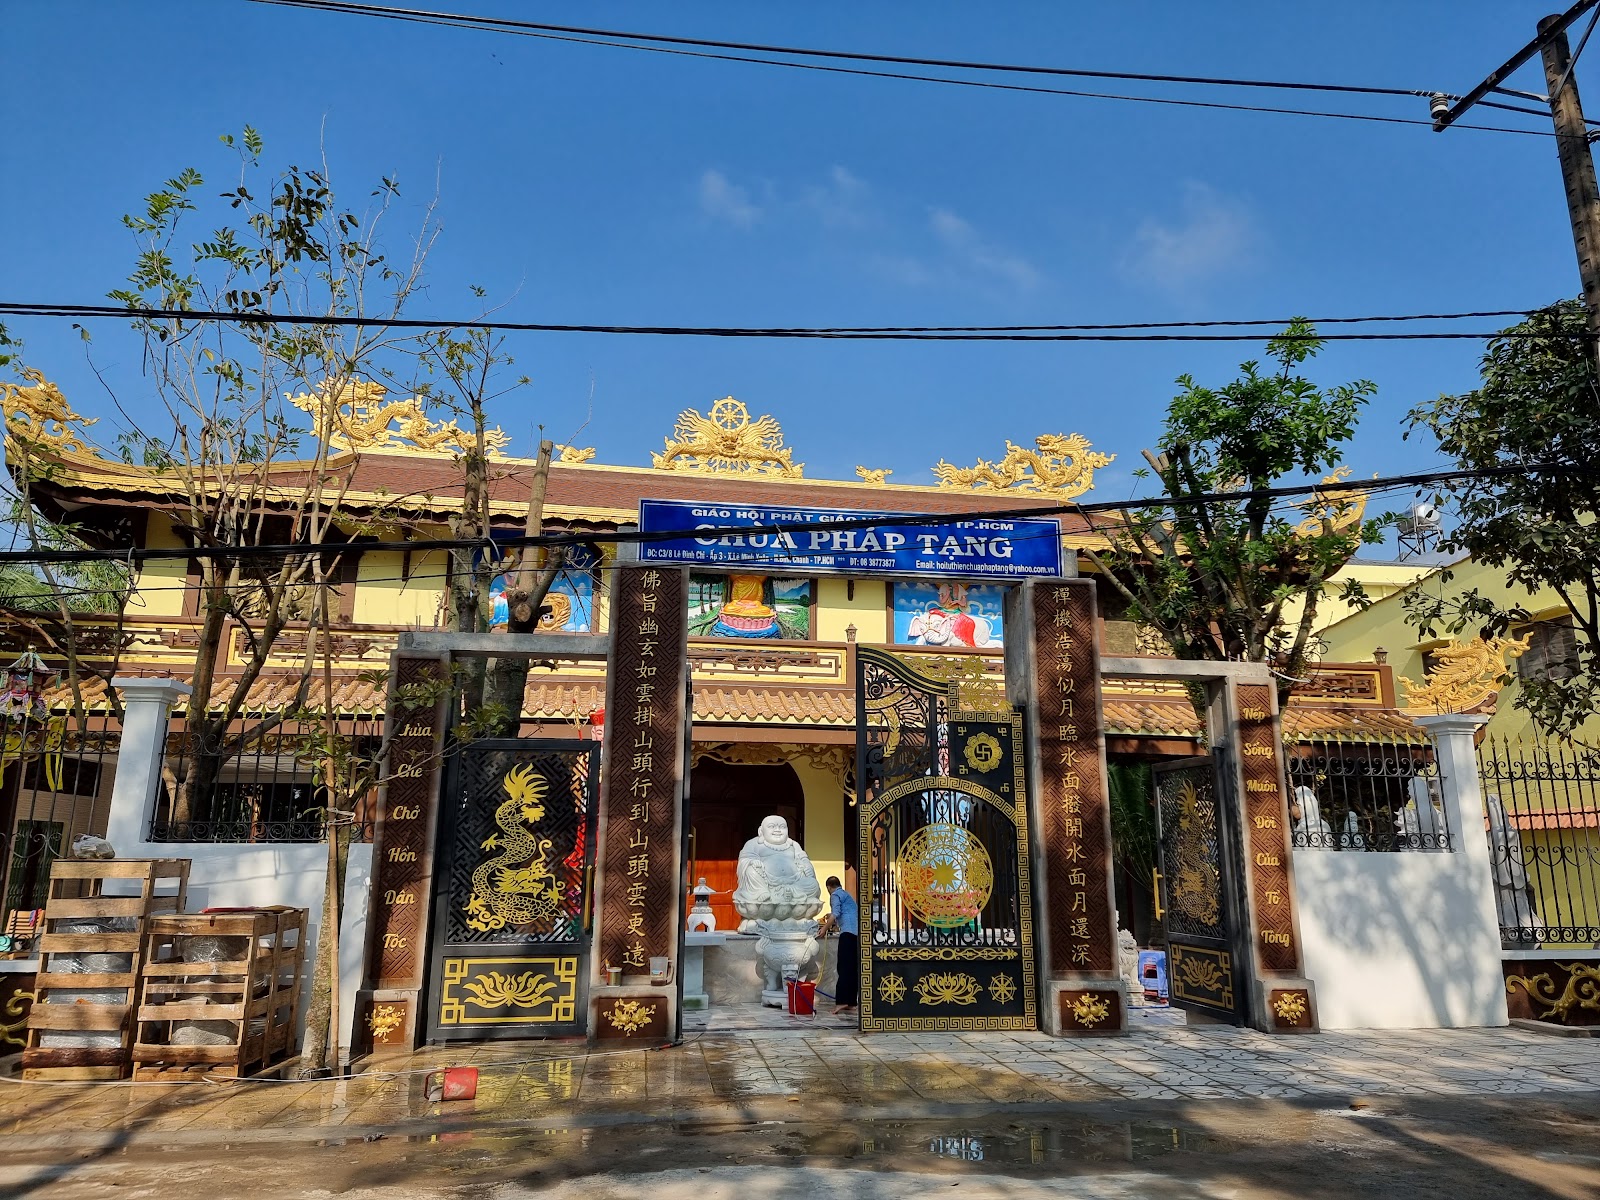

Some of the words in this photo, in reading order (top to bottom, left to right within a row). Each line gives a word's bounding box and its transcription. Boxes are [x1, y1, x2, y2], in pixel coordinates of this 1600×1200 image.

[691, 507, 731, 518] GIÁO
[736, 510, 765, 520] HỘI
[770, 512, 814, 522] PHẬT
[956, 521, 1014, 531] TP.HCM
[808, 526, 906, 554] PHÁP
[916, 534, 1014, 561] TẠNG
[647, 548, 658, 558] ĐC:
[718, 552, 723, 560] 3
[915, 560, 935, 569] Email:
[1243, 706, 1266, 724] Nếp
[1243, 741, 1274, 760] Sống
[1247, 779, 1278, 793] Muôn
[392, 805, 421, 820] Chở
[1254, 815, 1277, 829] Đời
[388, 845, 417, 862] Hồn
[1256, 852, 1281, 866] Của
[384, 889, 415, 905] Dân
[1265, 889, 1281, 905] Tổ
[382, 933, 407, 952] Tộc
[1260, 930, 1290, 948] Tông
